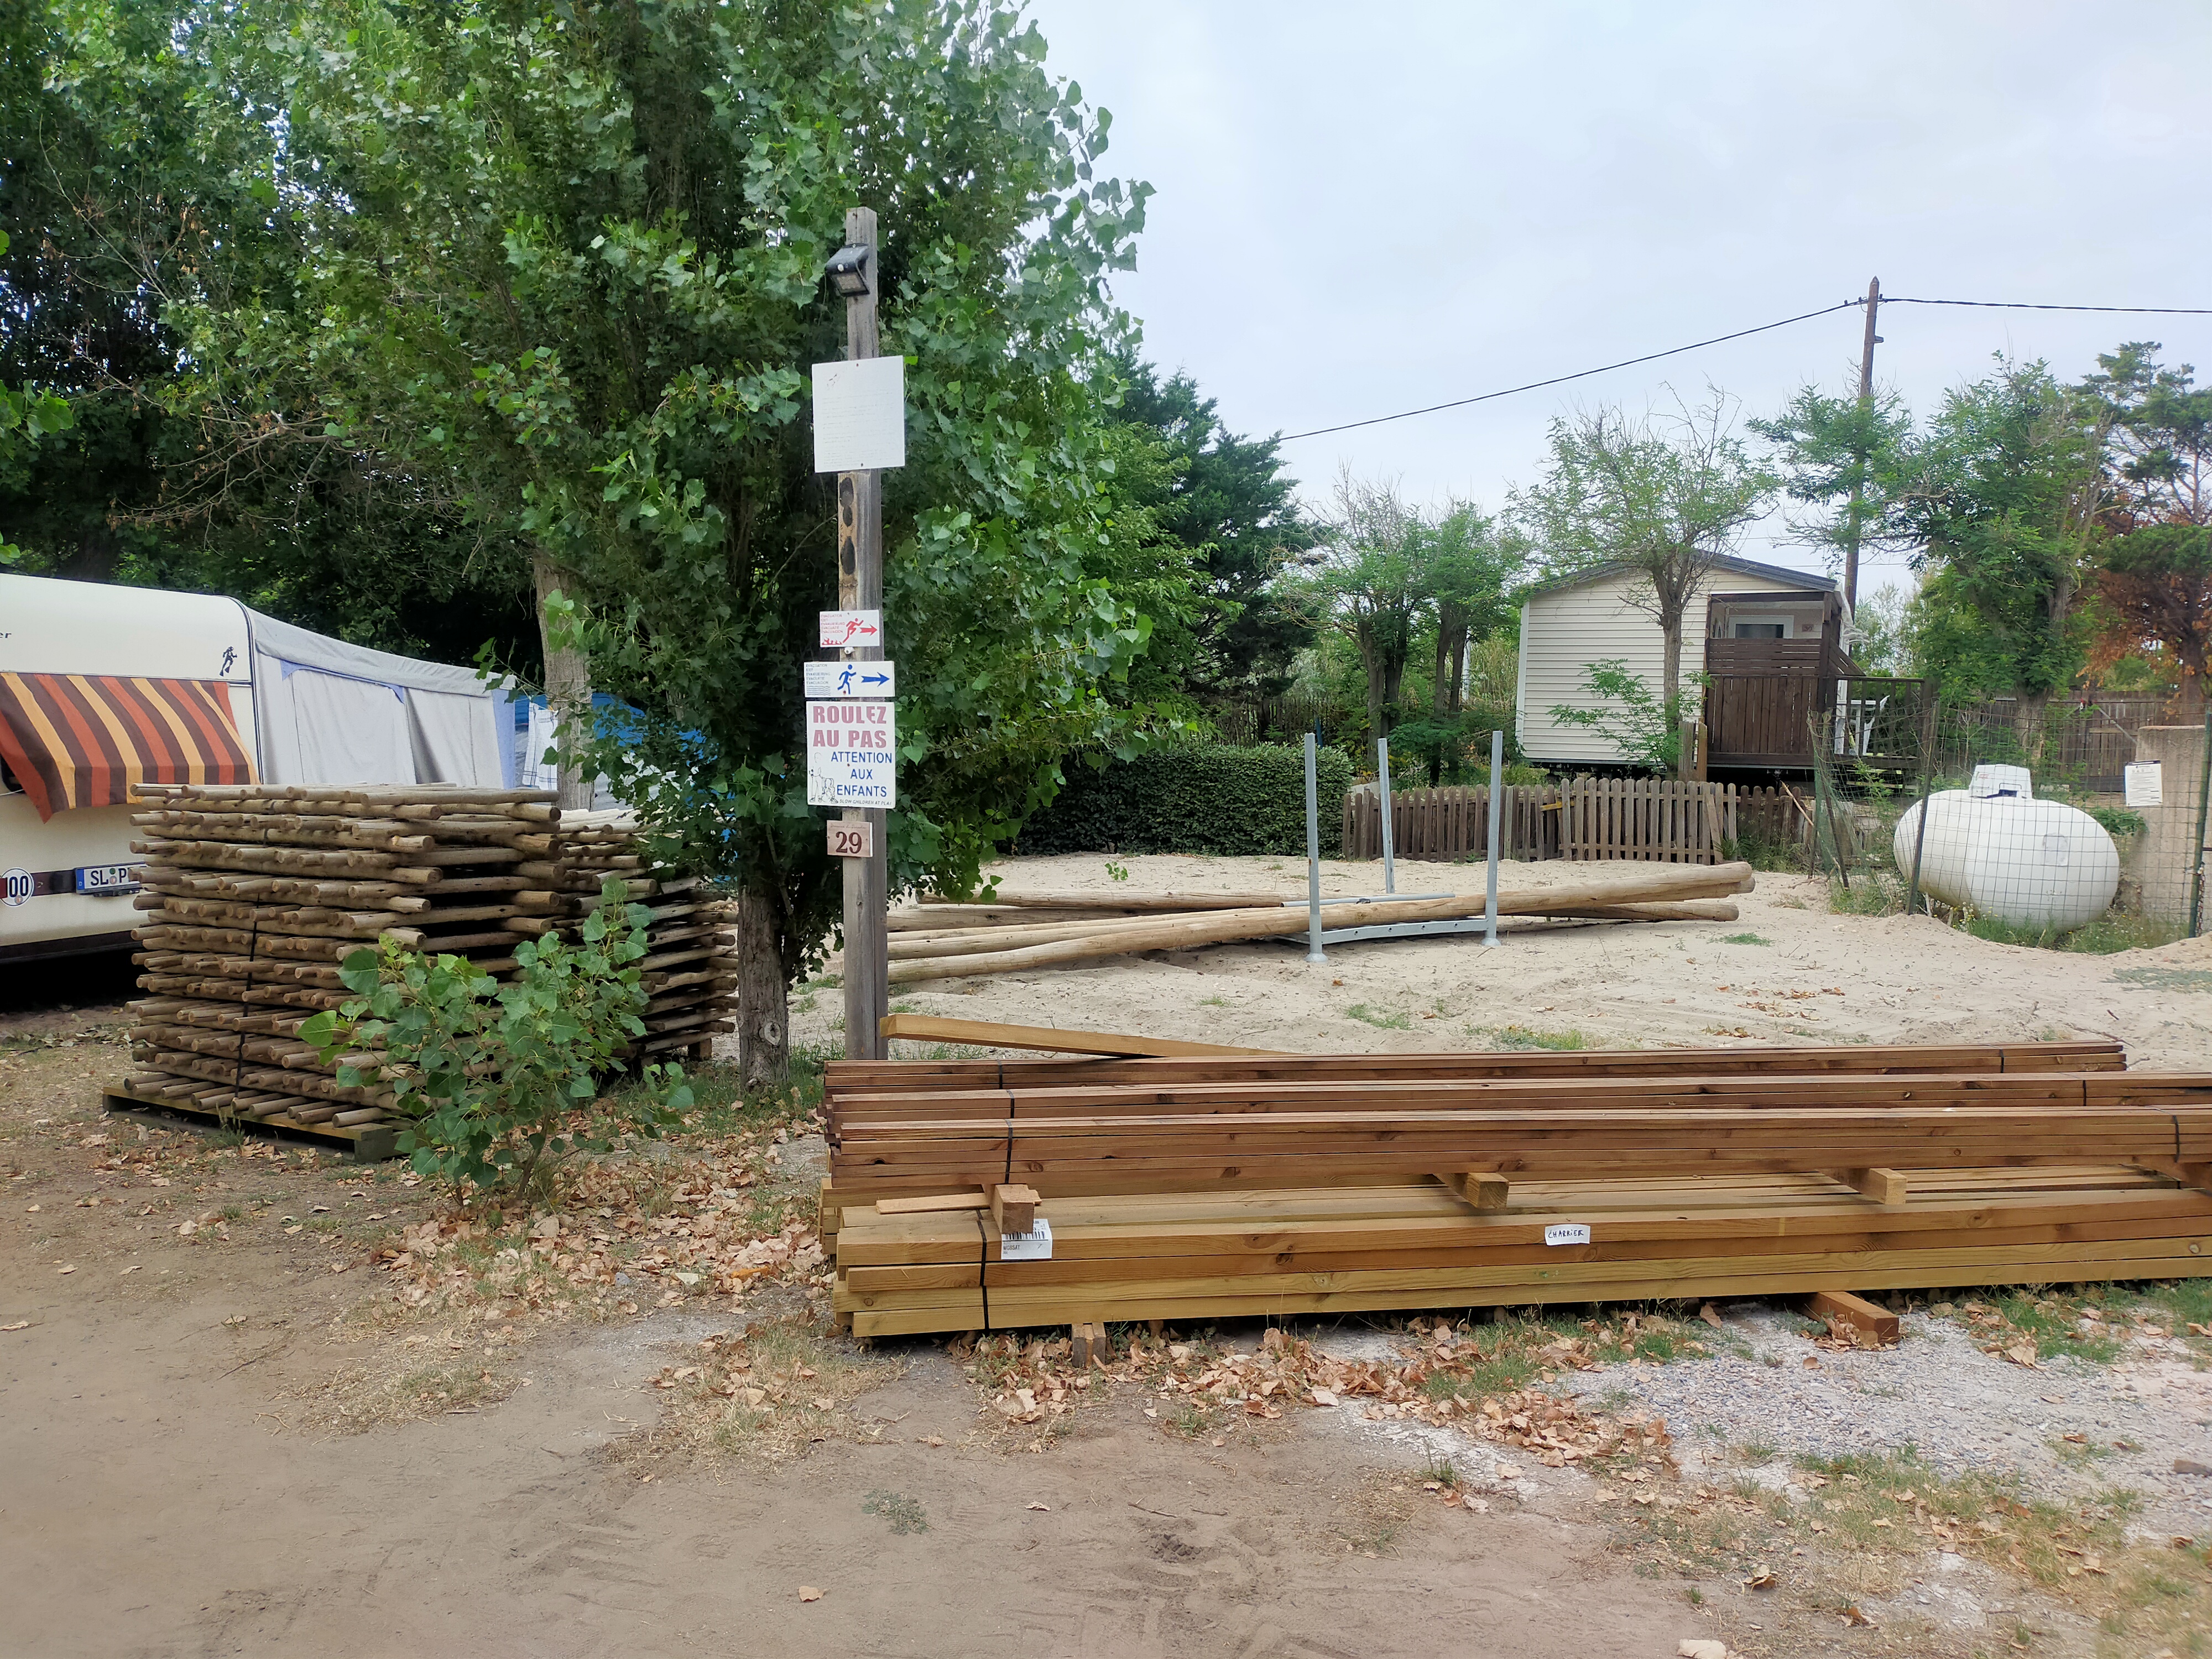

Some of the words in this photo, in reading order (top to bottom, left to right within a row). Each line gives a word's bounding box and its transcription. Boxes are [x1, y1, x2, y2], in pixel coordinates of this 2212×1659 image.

[813, 706, 886, 724] ROULEZ
[813, 729, 839, 747] AU
[848, 730, 886, 748] PAS
[831, 752, 892, 763] ATTENTION
[850, 769, 873, 779] AUX
[837, 785, 886, 797] ENFANTS
[836, 831, 862, 854] 29
[9, 875, 29, 898] 00
